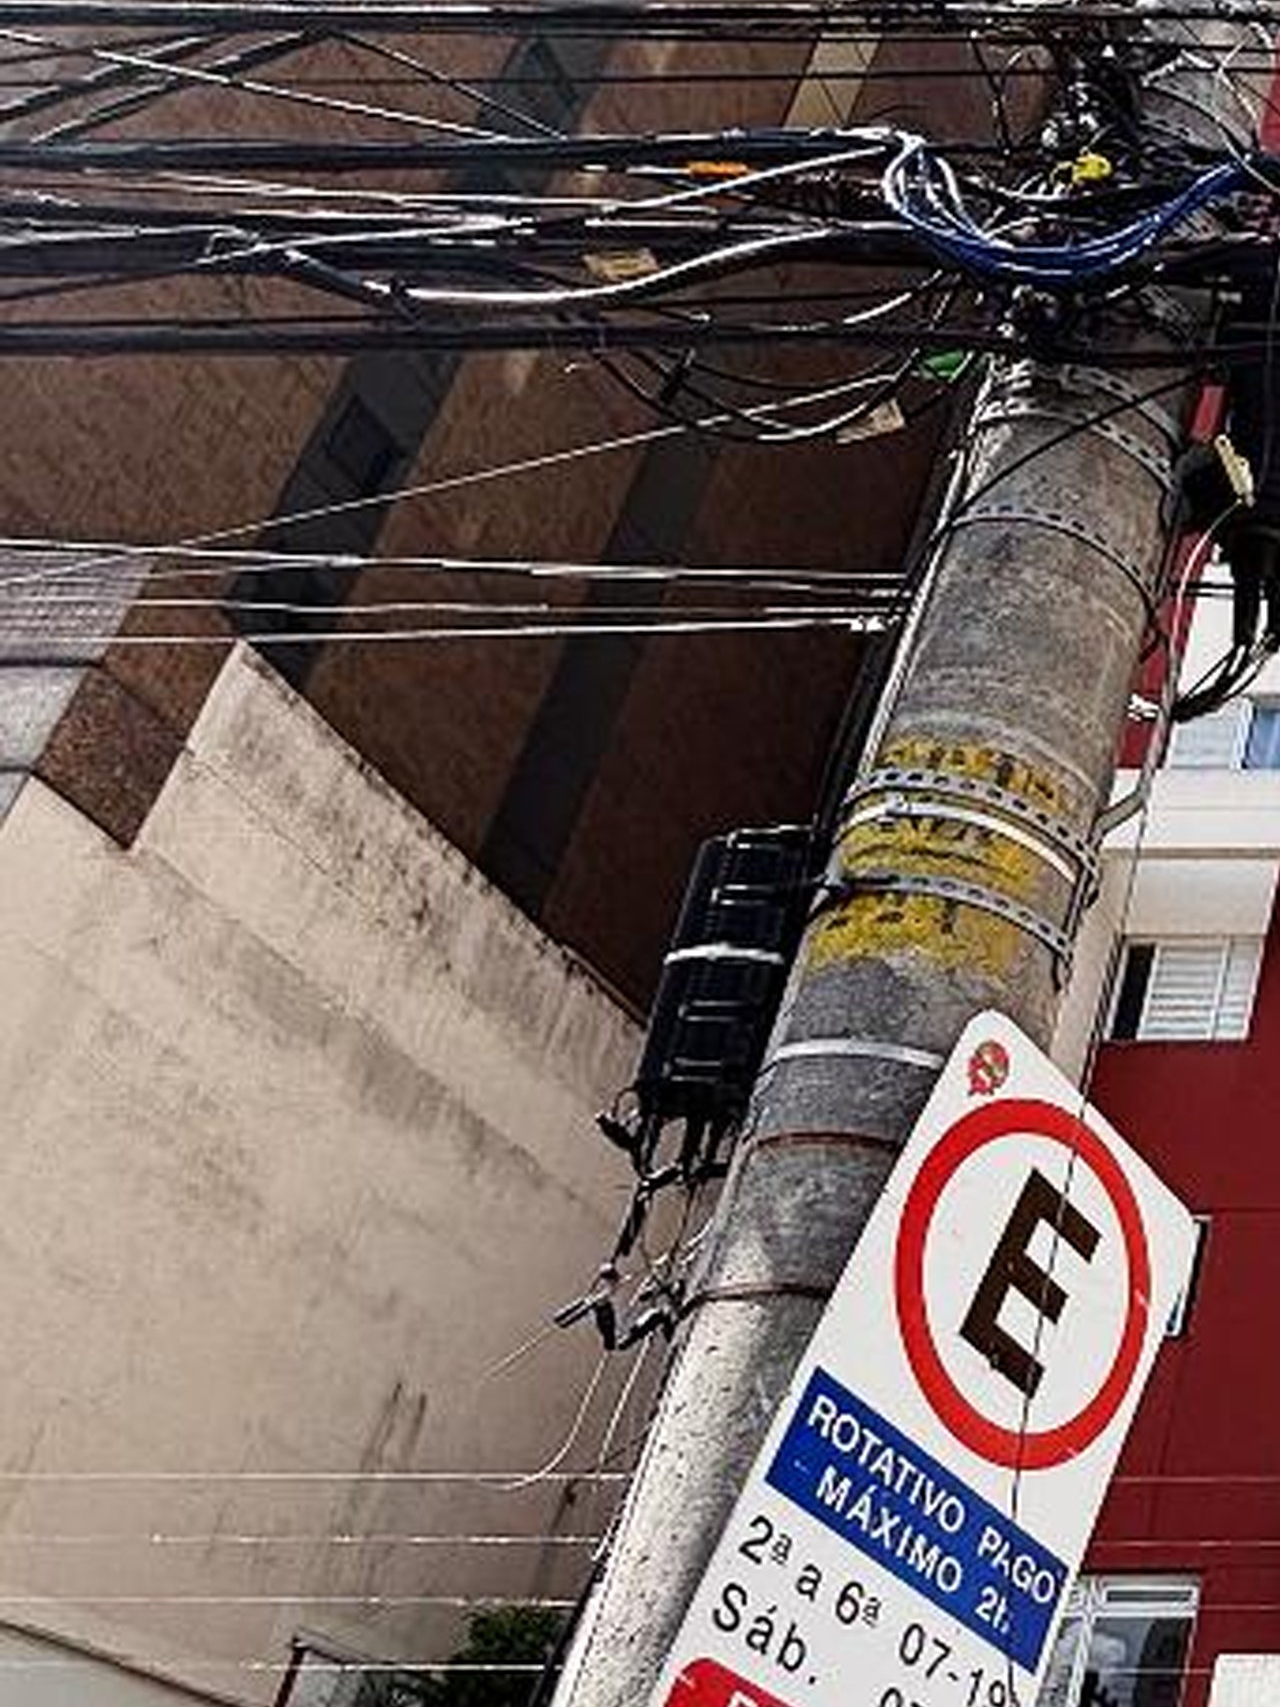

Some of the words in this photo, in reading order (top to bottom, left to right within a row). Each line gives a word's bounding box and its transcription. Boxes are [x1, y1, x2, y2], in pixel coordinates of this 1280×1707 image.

[959, 1167, 1102, 1399] E
[807, 1393, 965, 1533] ROTATIVO
[977, 1525, 1055, 1603] PAGO
[815, 1464, 963, 1593] MÁXIMO
[712, 1582, 816, 1685] Sáb.
[795, 1563, 823, 1602] a
